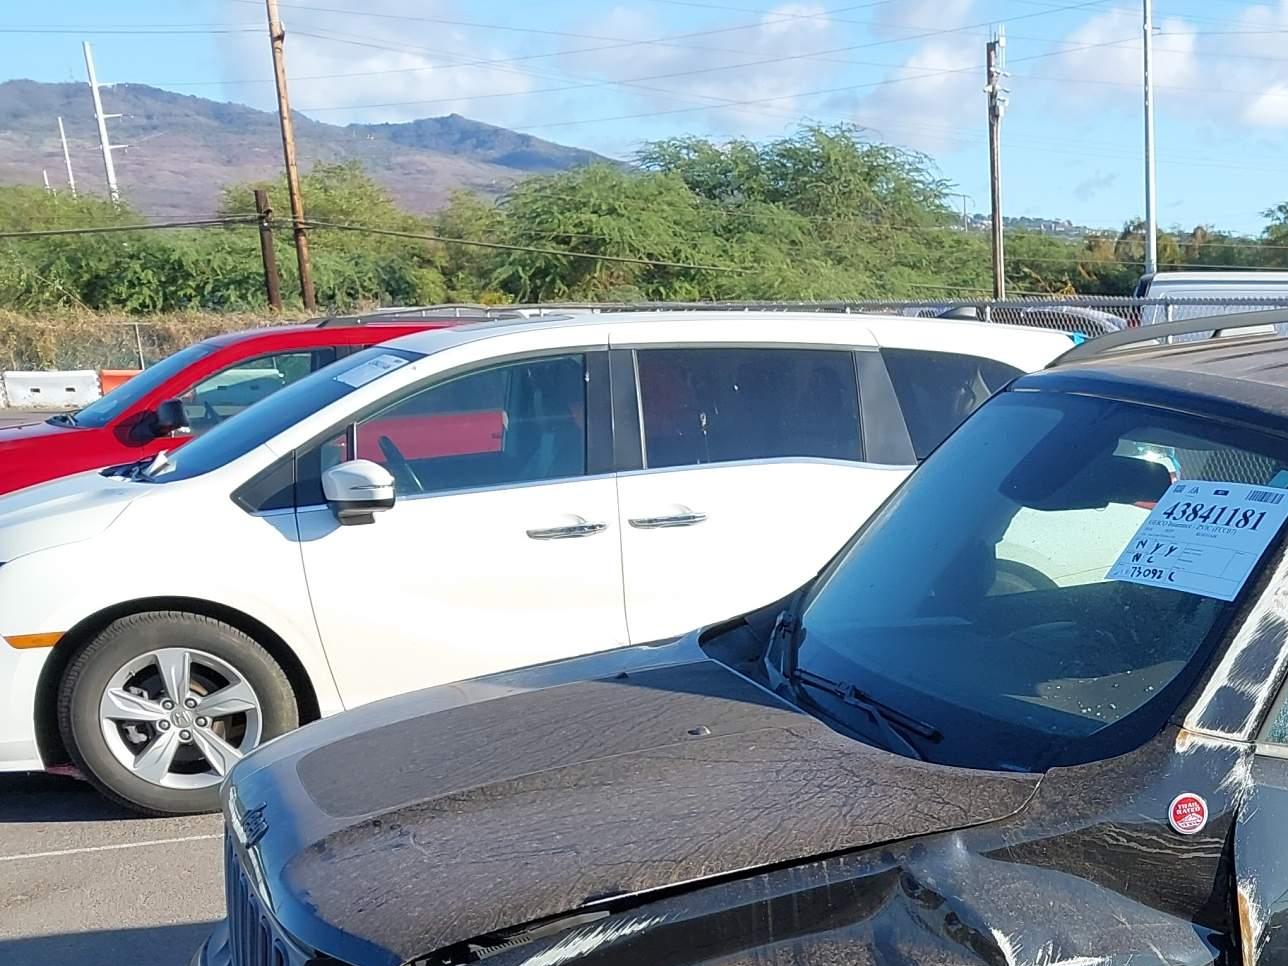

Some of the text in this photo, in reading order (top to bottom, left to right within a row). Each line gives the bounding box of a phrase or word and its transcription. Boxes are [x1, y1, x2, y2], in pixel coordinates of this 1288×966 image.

[1163, 501, 1267, 531] 43841181
[1176, 806, 1201, 816] RATED
[1178, 802, 1200, 810] TRAIL
